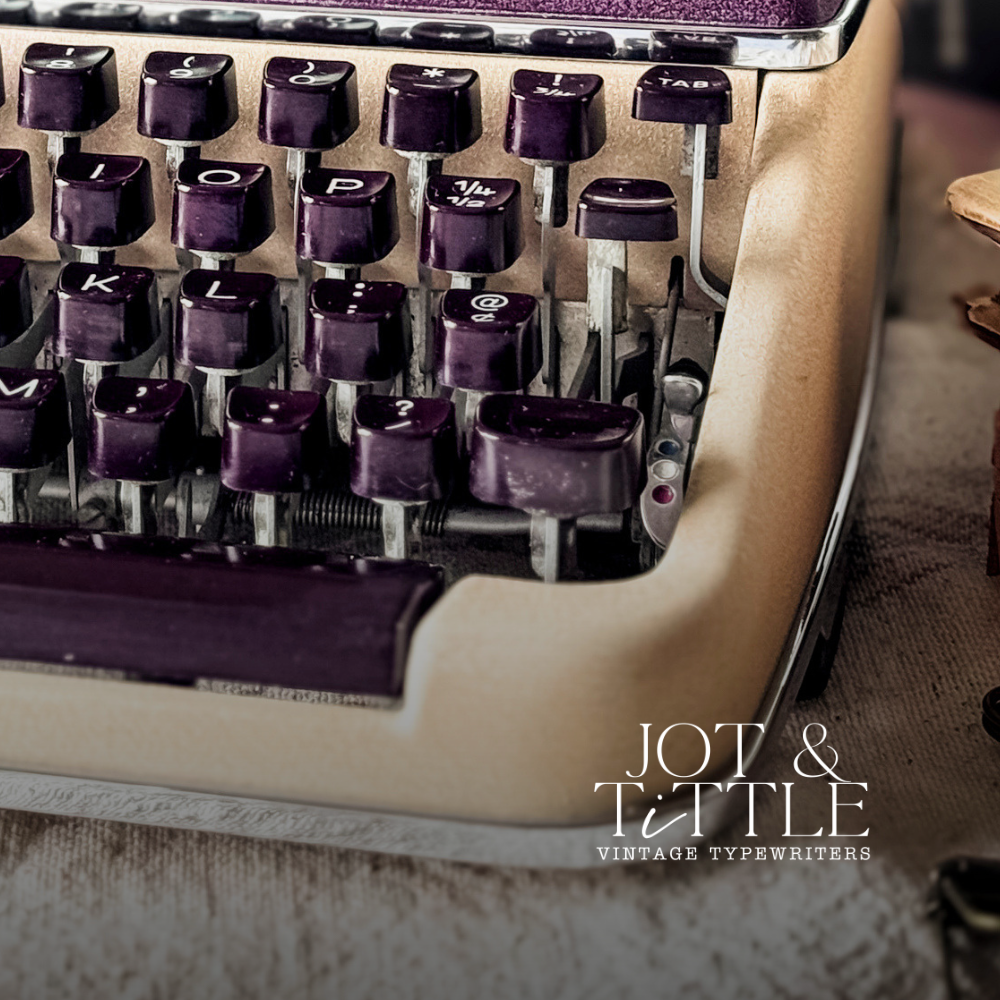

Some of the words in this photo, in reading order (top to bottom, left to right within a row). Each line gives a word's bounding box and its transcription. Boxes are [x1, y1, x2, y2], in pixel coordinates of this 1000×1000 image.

[46, 59, 77, 70] 8
[168, 68, 194, 79] 9
[658, 77, 709, 89] TAB
[89, 163, 105, 179] I
[197, 169, 241, 185] O
[325, 177, 364, 194] P
[453, 178, 497, 198] 1/4
[446, 193, 487, 208] 1/2
[80, 273, 120, 293] K
[205, 280, 237, 300] L
[470, 293, 509, 312] @
[395, 399, 415, 417] ?
